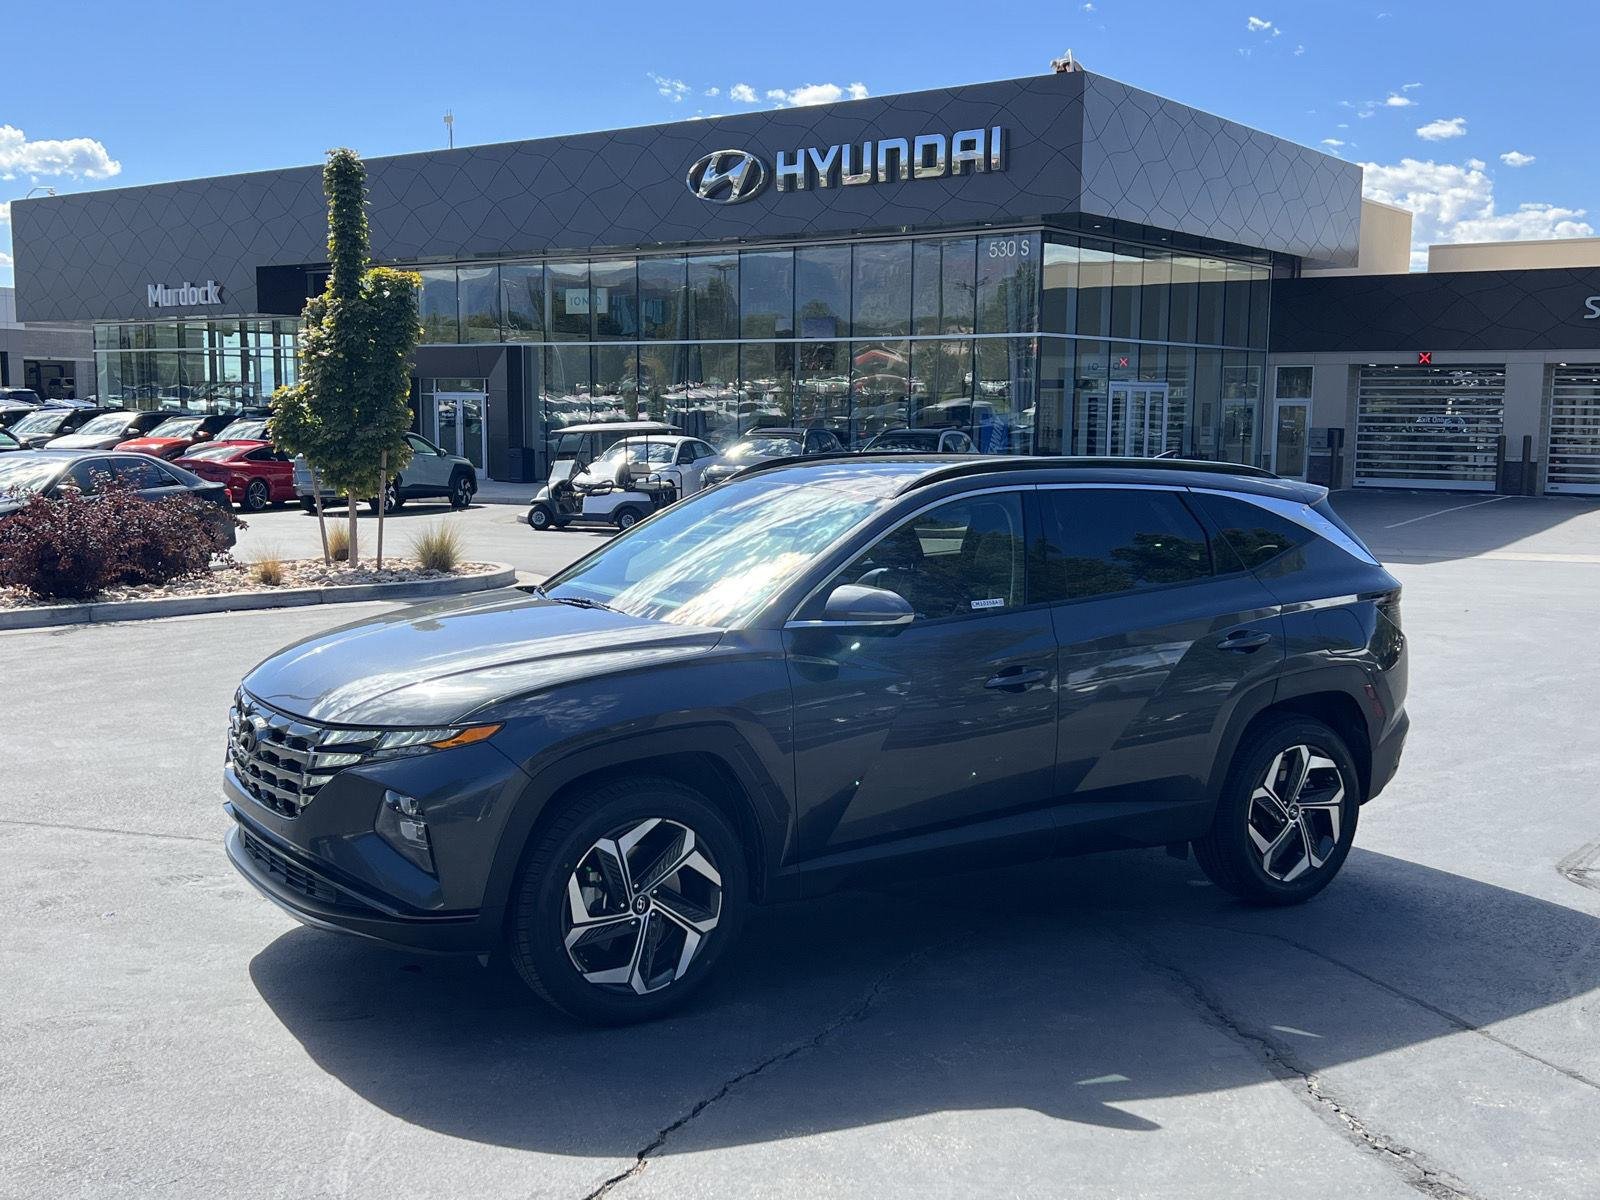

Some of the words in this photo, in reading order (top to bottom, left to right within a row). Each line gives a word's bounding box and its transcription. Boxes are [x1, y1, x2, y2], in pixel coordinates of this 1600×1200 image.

[776, 126, 1004, 192] HYUNDAI
[989, 240, 1016, 258] 530
[1020, 239, 1030, 256] S
[147, 280, 222, 308] Murdock
